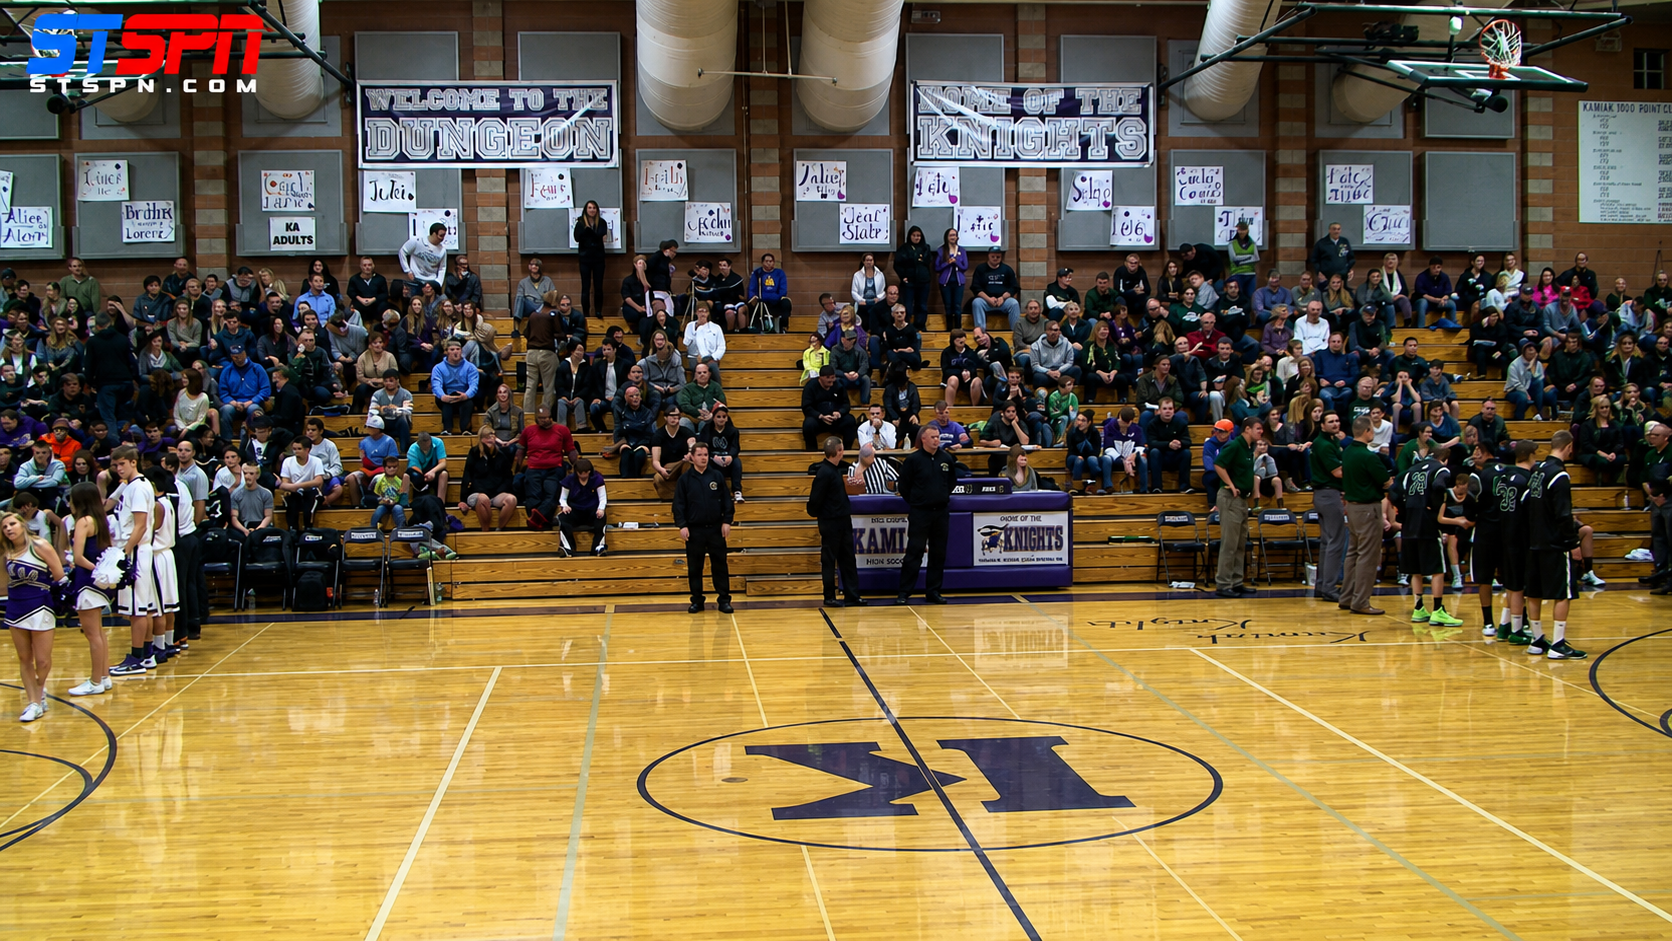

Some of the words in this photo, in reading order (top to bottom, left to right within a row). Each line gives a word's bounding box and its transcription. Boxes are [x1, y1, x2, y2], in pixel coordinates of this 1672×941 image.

[365, 88, 500, 111] WELCOME
[509, 88, 544, 111] TO
[553, 88, 608, 111] THE
[1023, 88, 1064, 115] OF
[1075, 87, 1142, 115] THE
[1639, 104, 1661, 113] POINT
[1664, 104, 1672, 114] CL
[365, 117, 613, 160] DUNGEON
[917, 117, 1148, 160] KNIGHTS
[273, 235, 314, 245] ADULTS
[285, 222, 301, 232] KA
[852, 527, 907, 554] KAMI
[1003, 525, 1064, 552] KNIGHTS
